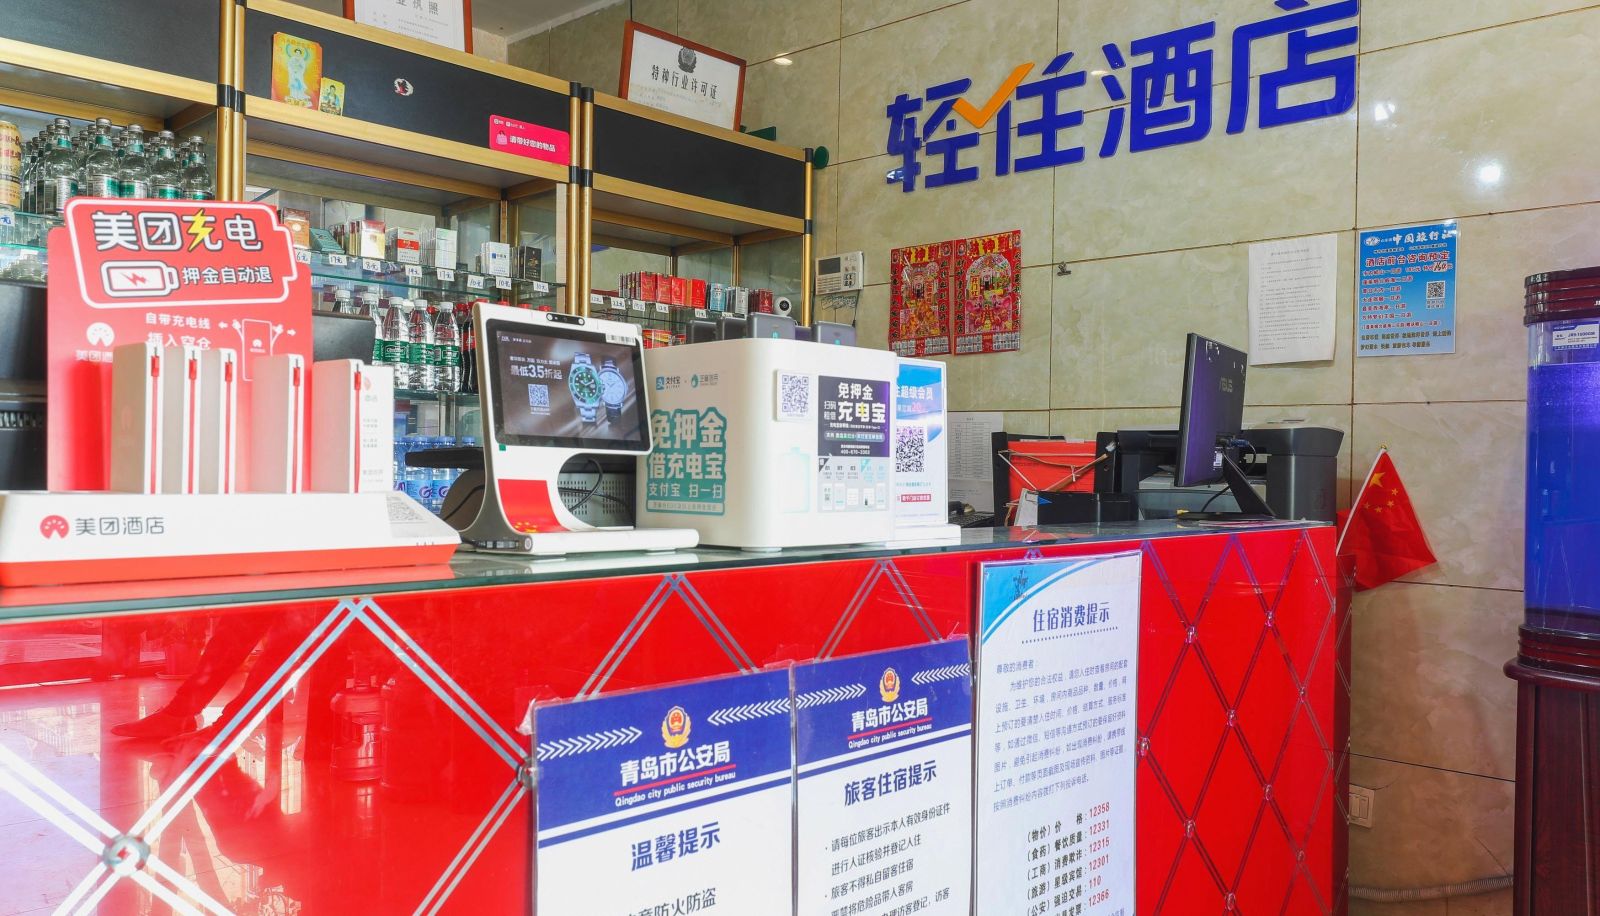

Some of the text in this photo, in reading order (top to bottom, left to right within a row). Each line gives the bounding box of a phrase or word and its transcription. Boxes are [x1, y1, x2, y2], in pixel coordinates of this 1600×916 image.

[651, 64, 718, 100] 特种行业许可证
[886, 0, 1359, 193] 轻住酒店
[510, 135, 556, 153] 请带好您的物品
[91, 207, 263, 252] 美团充电
[1366, 250, 1451, 267] 酒店前台咨询预定
[182, 264, 273, 286] 押金自动退
[145, 312, 211, 330] 自带充电线
[665, 375, 681, 385] 支付宝
[838, 382, 873, 401] 免押金
[837, 401, 886, 424] 充电宝
[652, 411, 723, 449] 免押金
[649, 452, 723, 480] 借充电宝
[649, 483, 723, 499] 支付宝 扫一扫
[75, 517, 165, 536] 美团酒店
[1033, 602, 1110, 633] 住宿消费提示
[851, 697, 928, 732] 青岛市公安局
[848, 723, 932, 749] Qingdao city public security bureau
[620, 740, 731, 787] 青岛市公安局
[615, 771, 736, 807] Qingdao city public security bureau
[843, 759, 938, 807] 旅客住宿提示
[631, 821, 721, 872] 温馨提示
